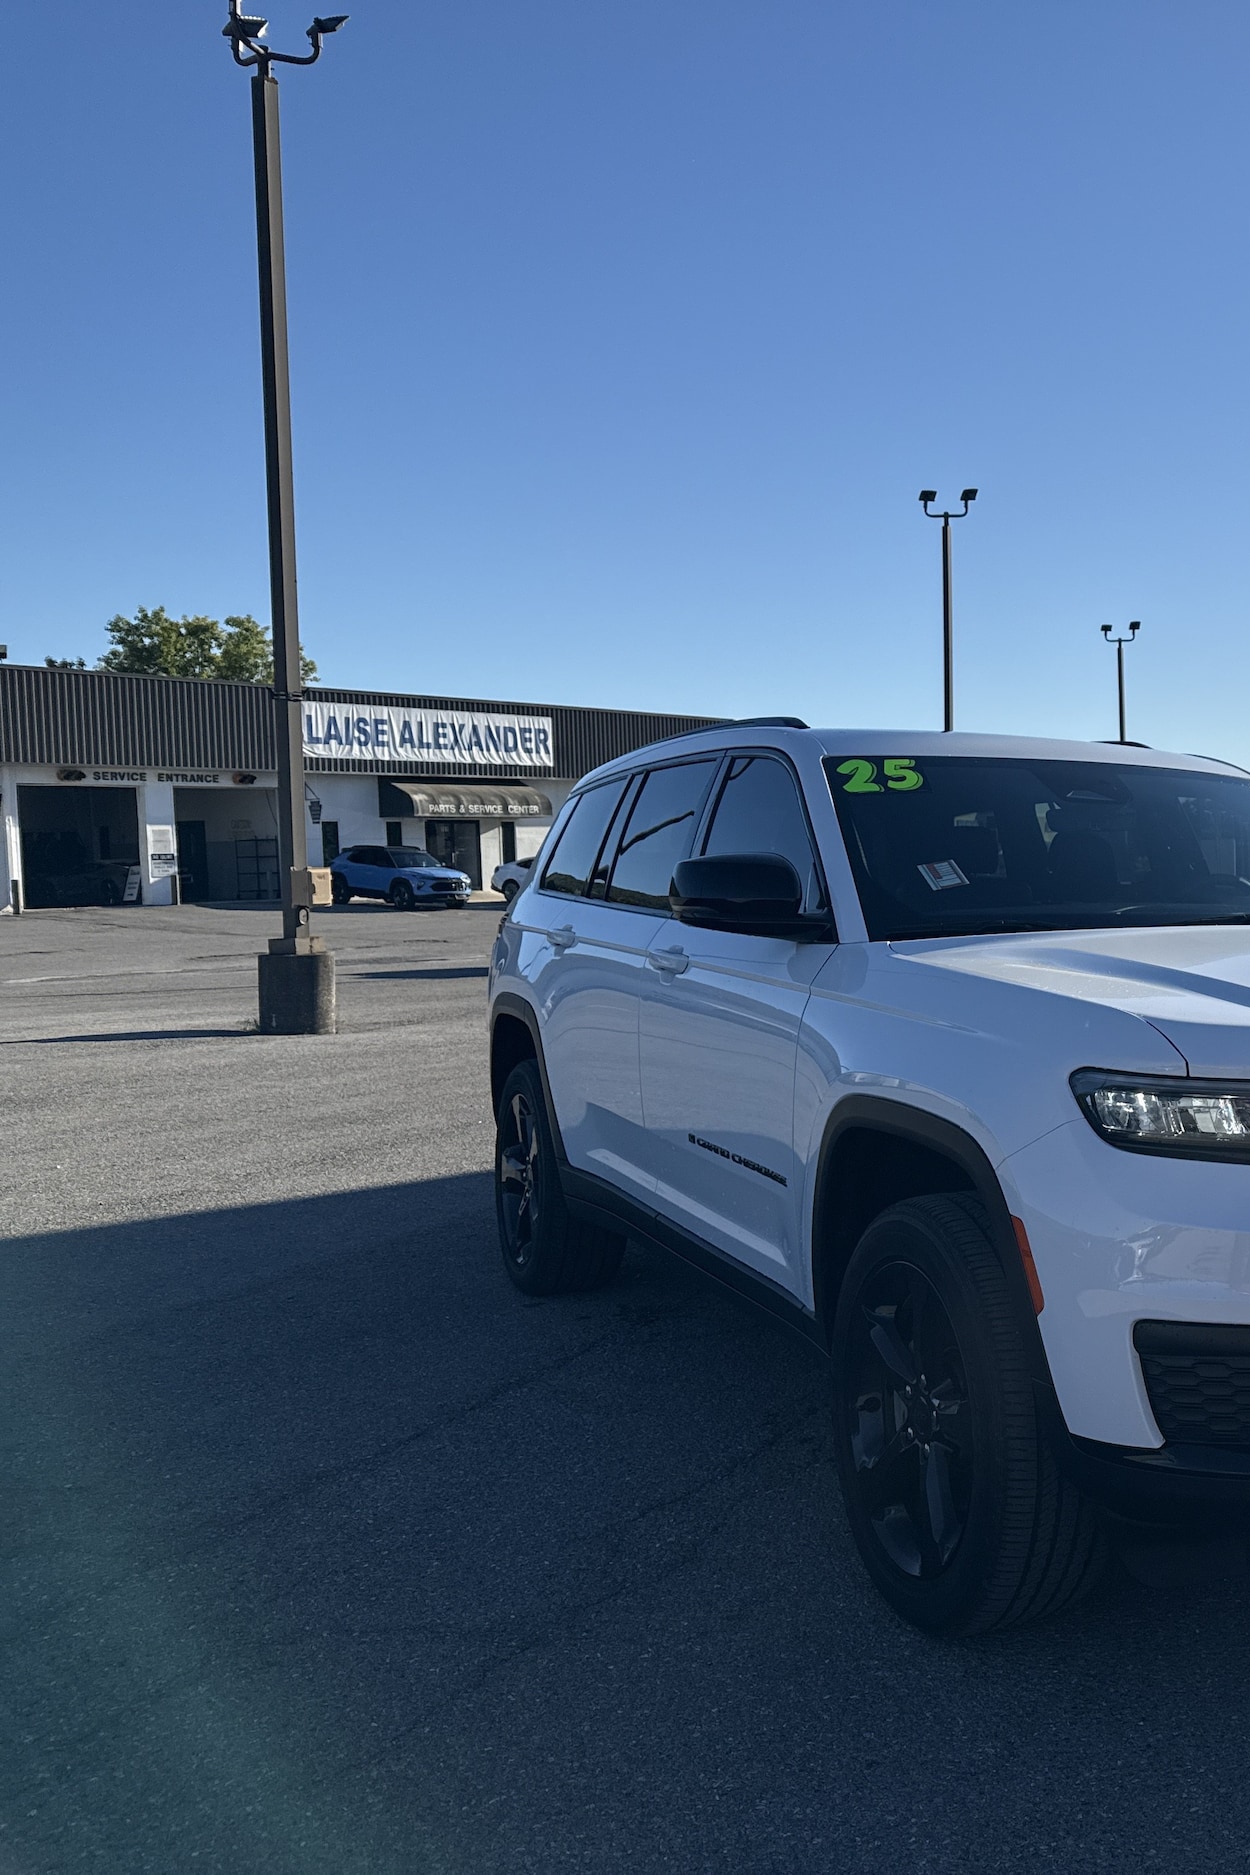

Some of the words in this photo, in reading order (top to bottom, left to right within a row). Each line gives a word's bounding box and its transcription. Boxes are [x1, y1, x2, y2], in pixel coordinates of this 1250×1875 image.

[306, 714, 388, 748] LAISE
[399, 720, 551, 755] ALEXANDER
[92, 771, 147, 782] SERVICE
[157, 772, 220, 784] ENTRANCE
[836, 758, 924, 793] 25
[428, 803, 456, 813] PARTS
[459, 804, 466, 813] &
[468, 804, 503, 814] SERVICE
[507, 804, 540, 814] CENTER
